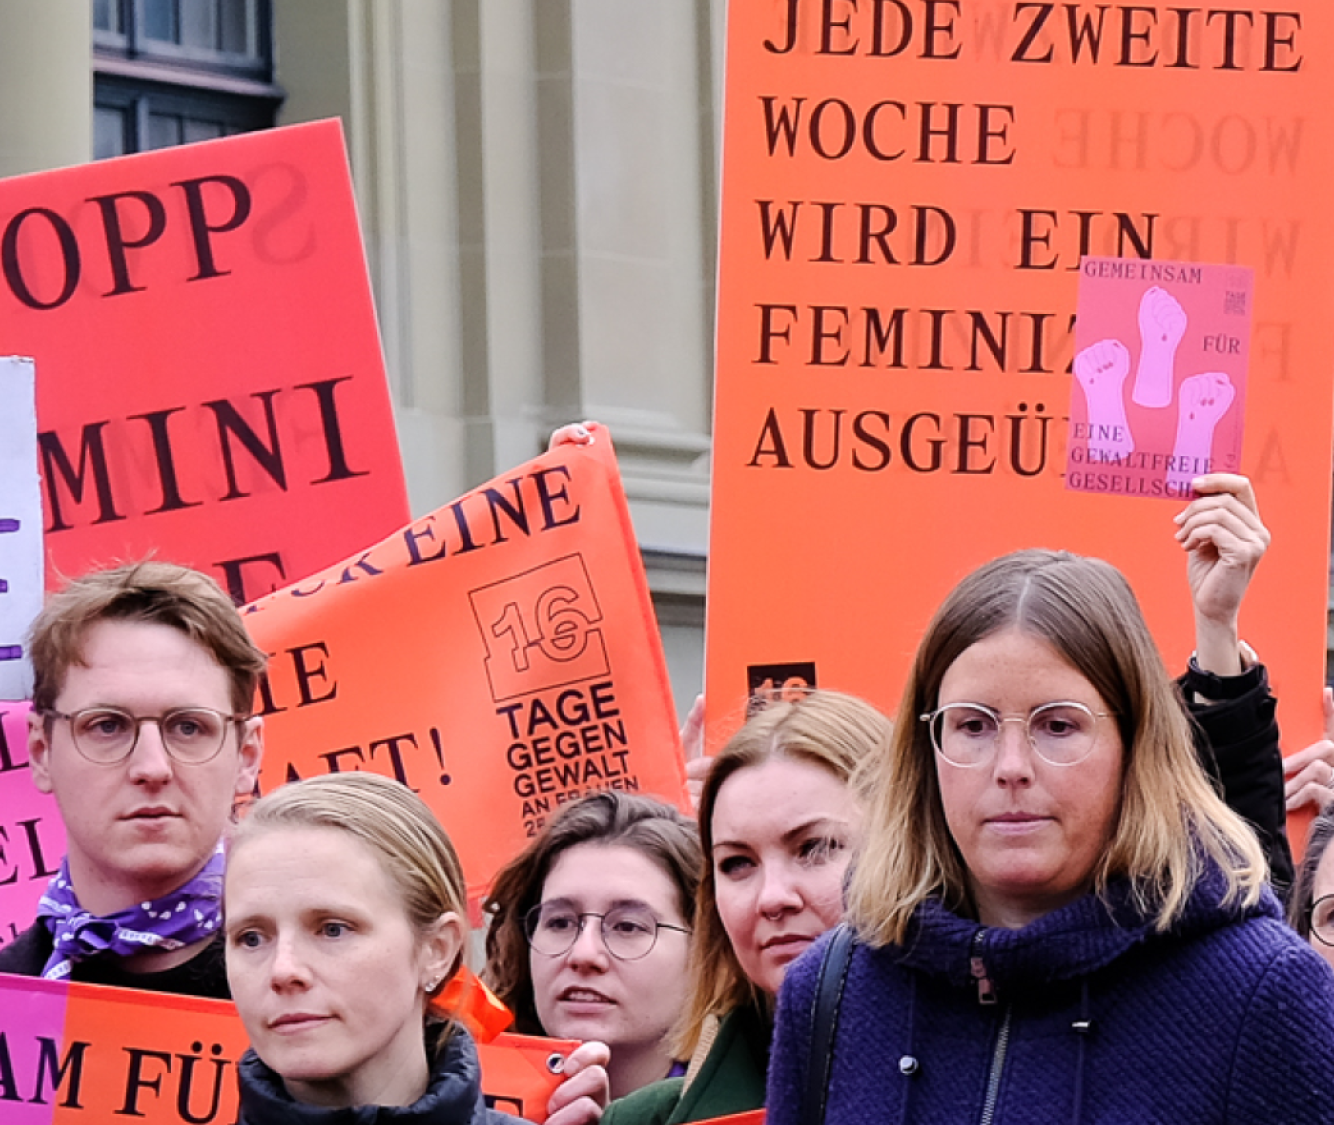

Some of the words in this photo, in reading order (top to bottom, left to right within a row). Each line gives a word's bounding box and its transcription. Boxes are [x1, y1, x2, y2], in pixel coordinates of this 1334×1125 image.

[763, 0, 963, 60] JEDE
[1010, 2, 1304, 72] ZWEITE
[758, 95, 1017, 165] WOCHE
[754, 199, 957, 267] WIRD
[1014, 208, 1160, 273] EIN
[1084, 261, 1202, 285] GEMEINSAM
[752, 303, 1075, 375] FEMINI
[1203, 333, 1241, 355] FÜR
[746, 402, 1070, 478] AUSGEÜ
[1073, 422, 1125, 443] EINE
[1069, 471, 1200, 499] GESELLSCH
[1071, 447, 1214, 475] GEWALTFREIE
[402, 464, 581, 567] EINE
[491, 586, 589, 672] 16
[496, 681, 621, 740] TAGE
[506, 720, 628, 772] GEGEN
[513, 750, 630, 799] GEWALT
[522, 797, 551, 818] AN
